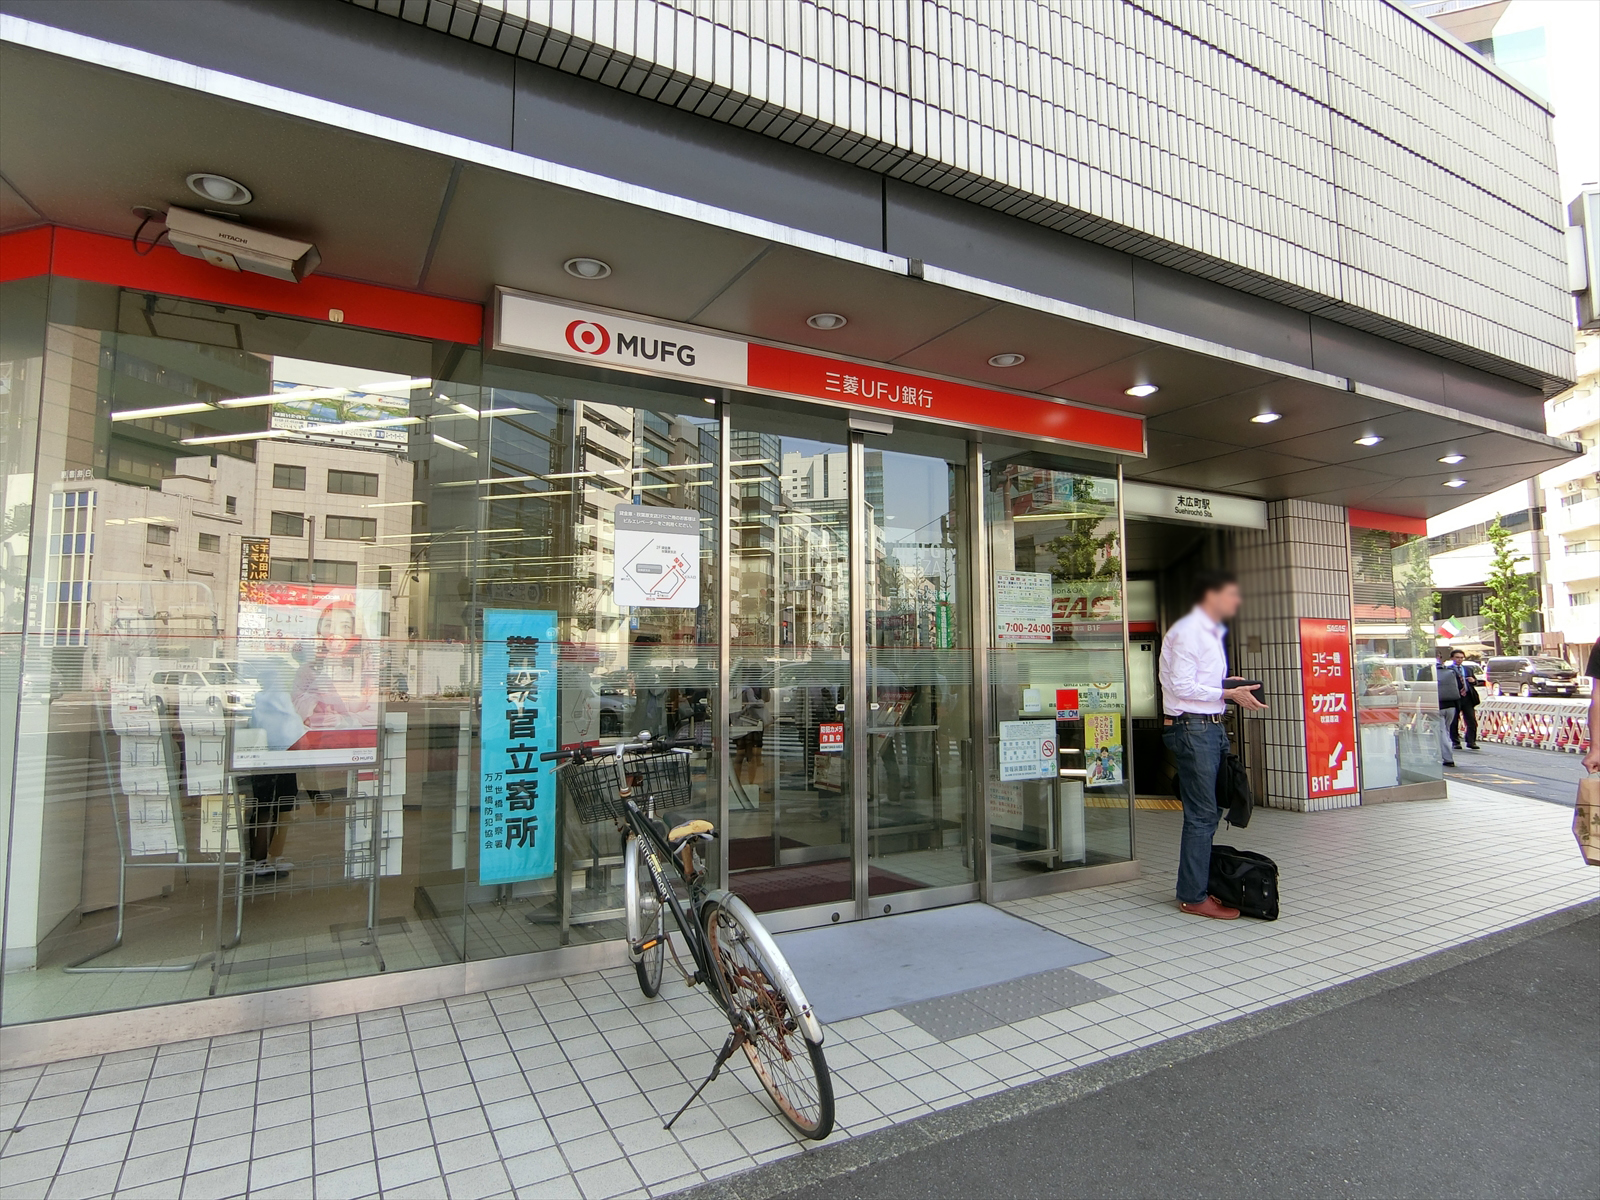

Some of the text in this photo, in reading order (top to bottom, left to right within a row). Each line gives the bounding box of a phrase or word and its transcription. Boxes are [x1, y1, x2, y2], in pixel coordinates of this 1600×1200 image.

[219, 233, 248, 244] HITACHI
[616, 332, 696, 367] MUFG
[824, 371, 934, 409] 三菱UFJ銀行
[1177, 495, 1210, 510] 末広町駅
[1052, 596, 1114, 618] GAS
[1326, 624, 1346, 632] SAGAS
[1312, 652, 1341, 664] コピー機
[1312, 666, 1341, 677] ワープロ
[1311, 692, 1347, 713] サガス
[820, 725, 843, 733] 防犯カメラ
[505, 636, 539, 851] 警察官立寄所
[1312, 775, 1330, 792] B1F
[484, 773, 493, 849] 万世橋防犯協会
[494, 772, 503, 849] 万世橋警察署
[637, 834, 670, 900] SOUTHERNPORT
